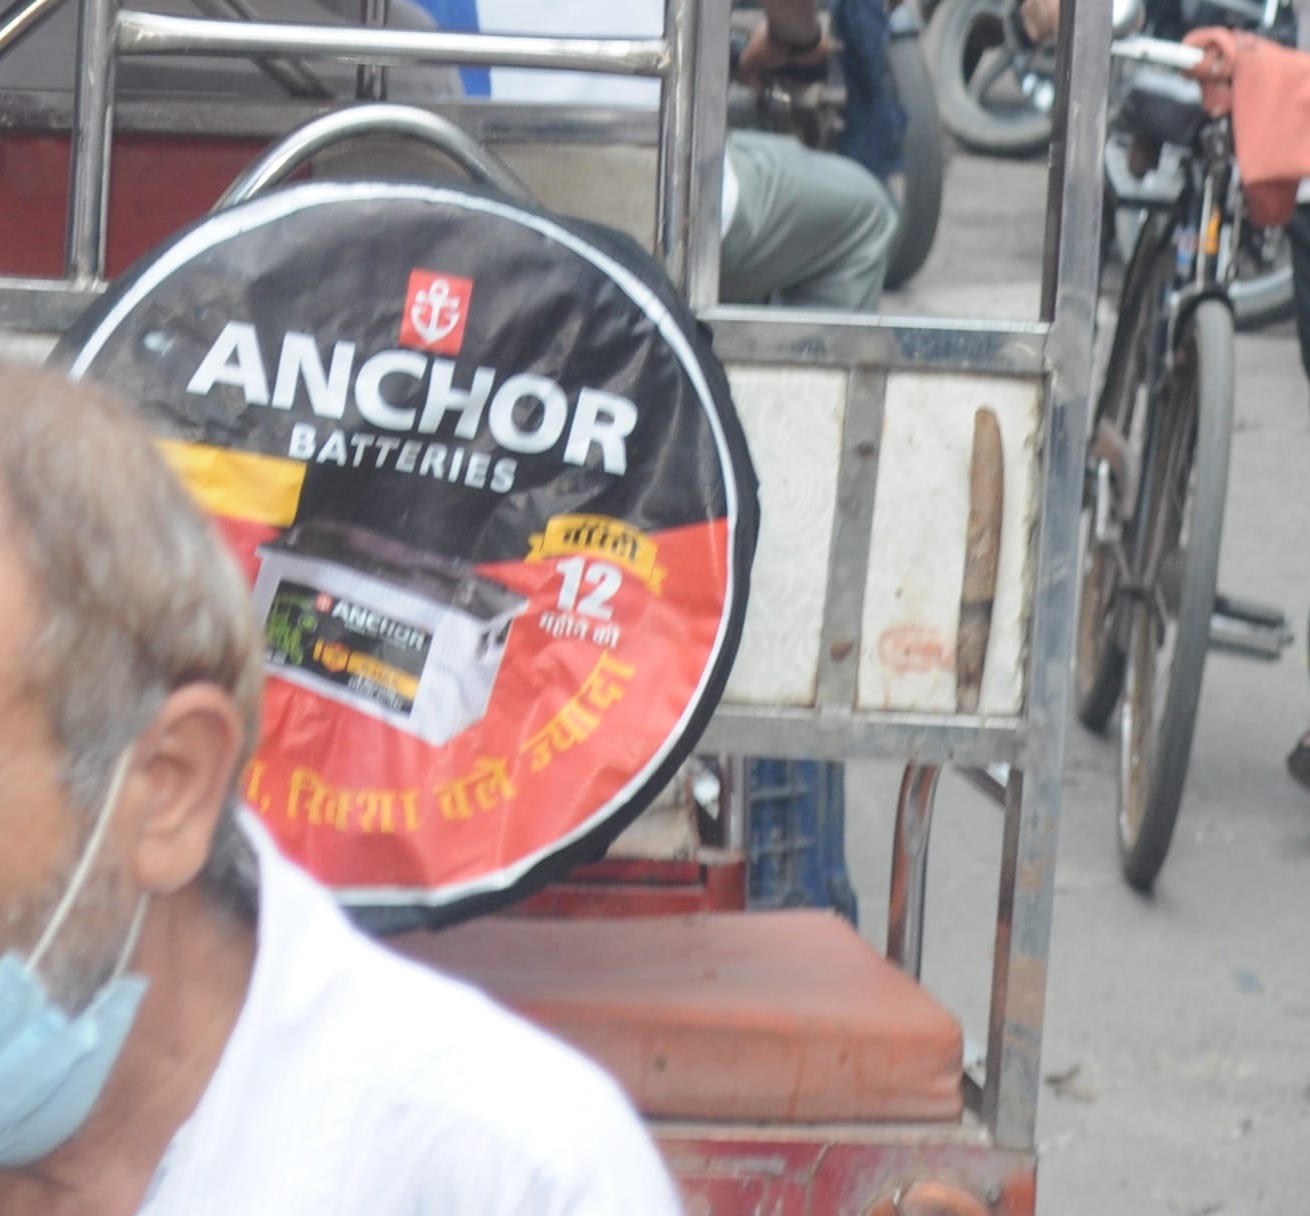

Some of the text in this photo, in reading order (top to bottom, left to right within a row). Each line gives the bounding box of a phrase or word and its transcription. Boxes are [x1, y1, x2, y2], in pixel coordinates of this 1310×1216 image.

[186, 320, 639, 476] ANCHOR
[288, 422, 518, 495] BATTERIES
[555, 556, 624, 621] 12
[332, 599, 426, 652] ANCHOR
